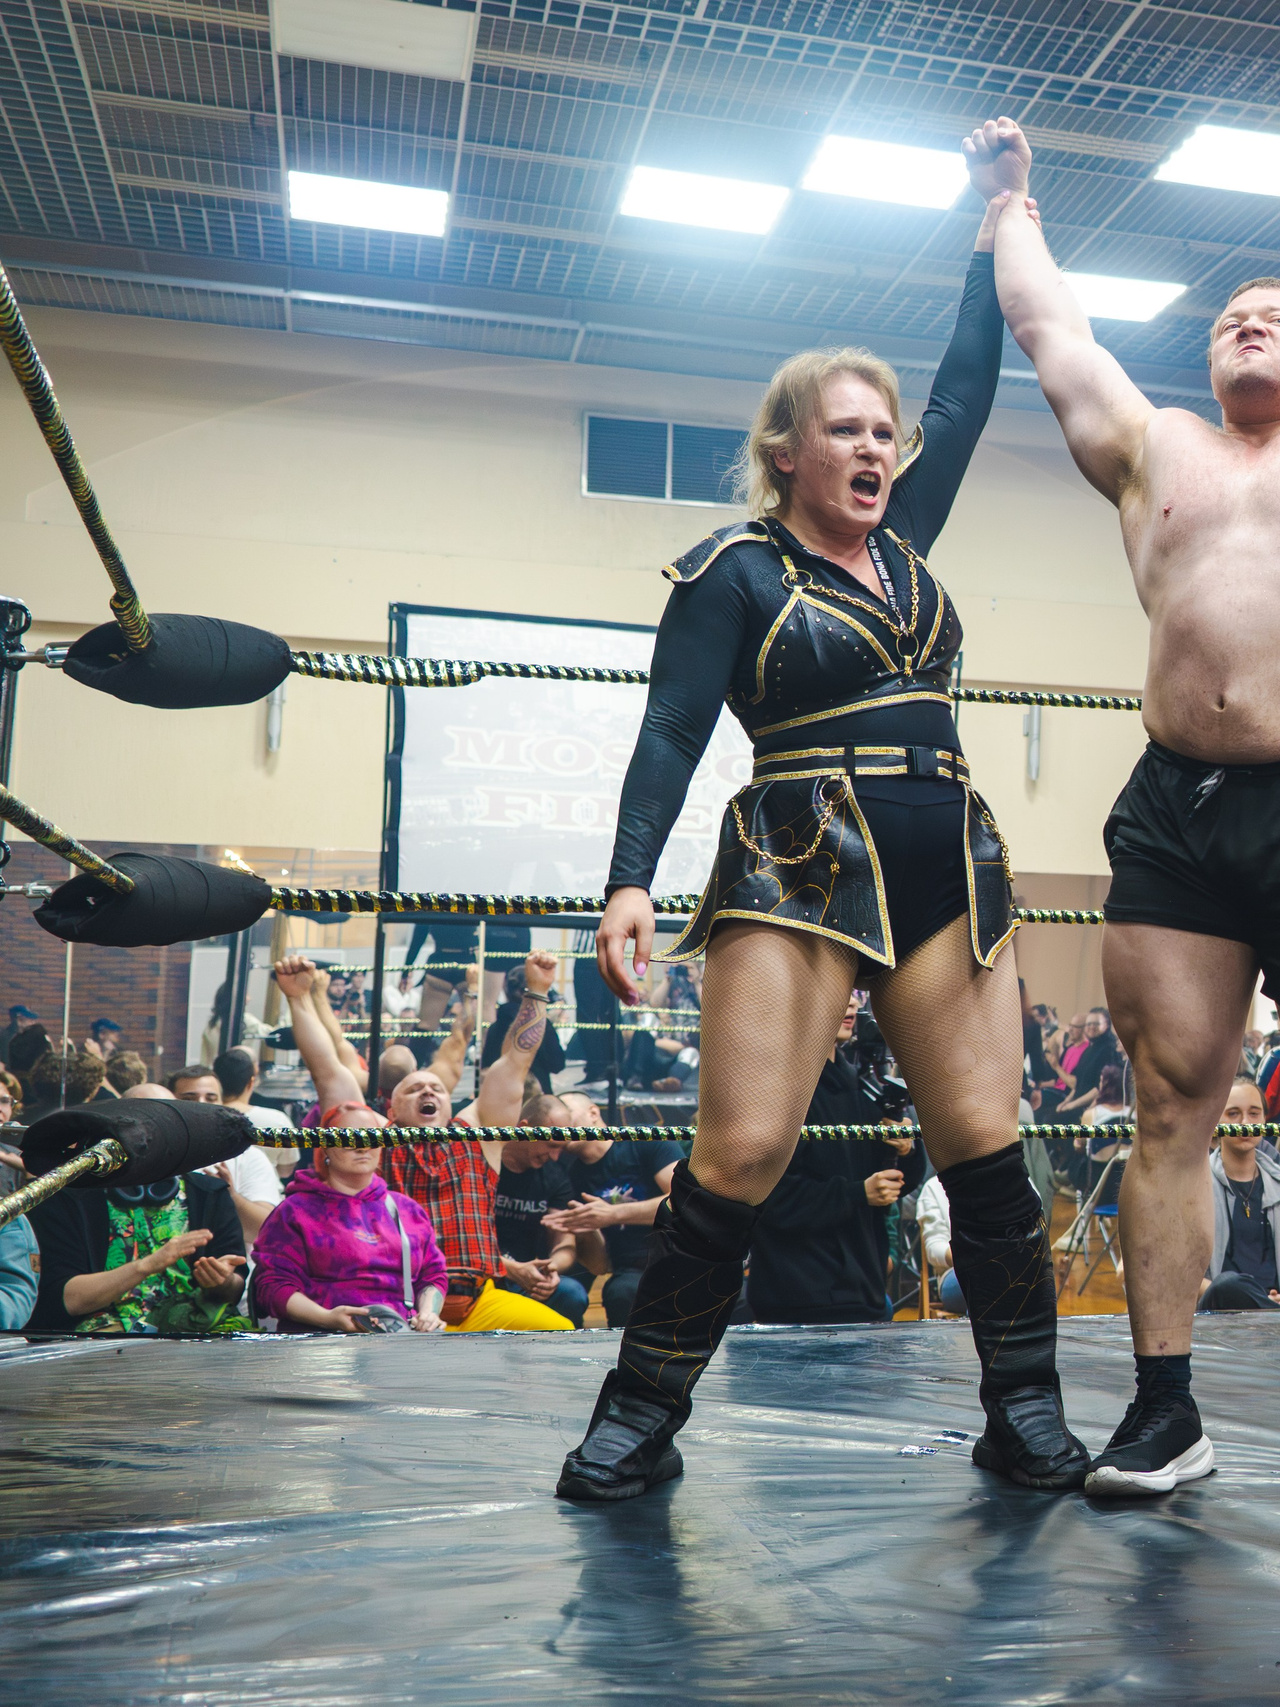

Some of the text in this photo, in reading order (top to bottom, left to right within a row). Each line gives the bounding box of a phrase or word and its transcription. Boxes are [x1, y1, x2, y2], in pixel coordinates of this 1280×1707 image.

[870, 547, 882, 561] FIDE
[876, 561, 890, 580] BONA
[883, 580, 896, 595] FIDE
